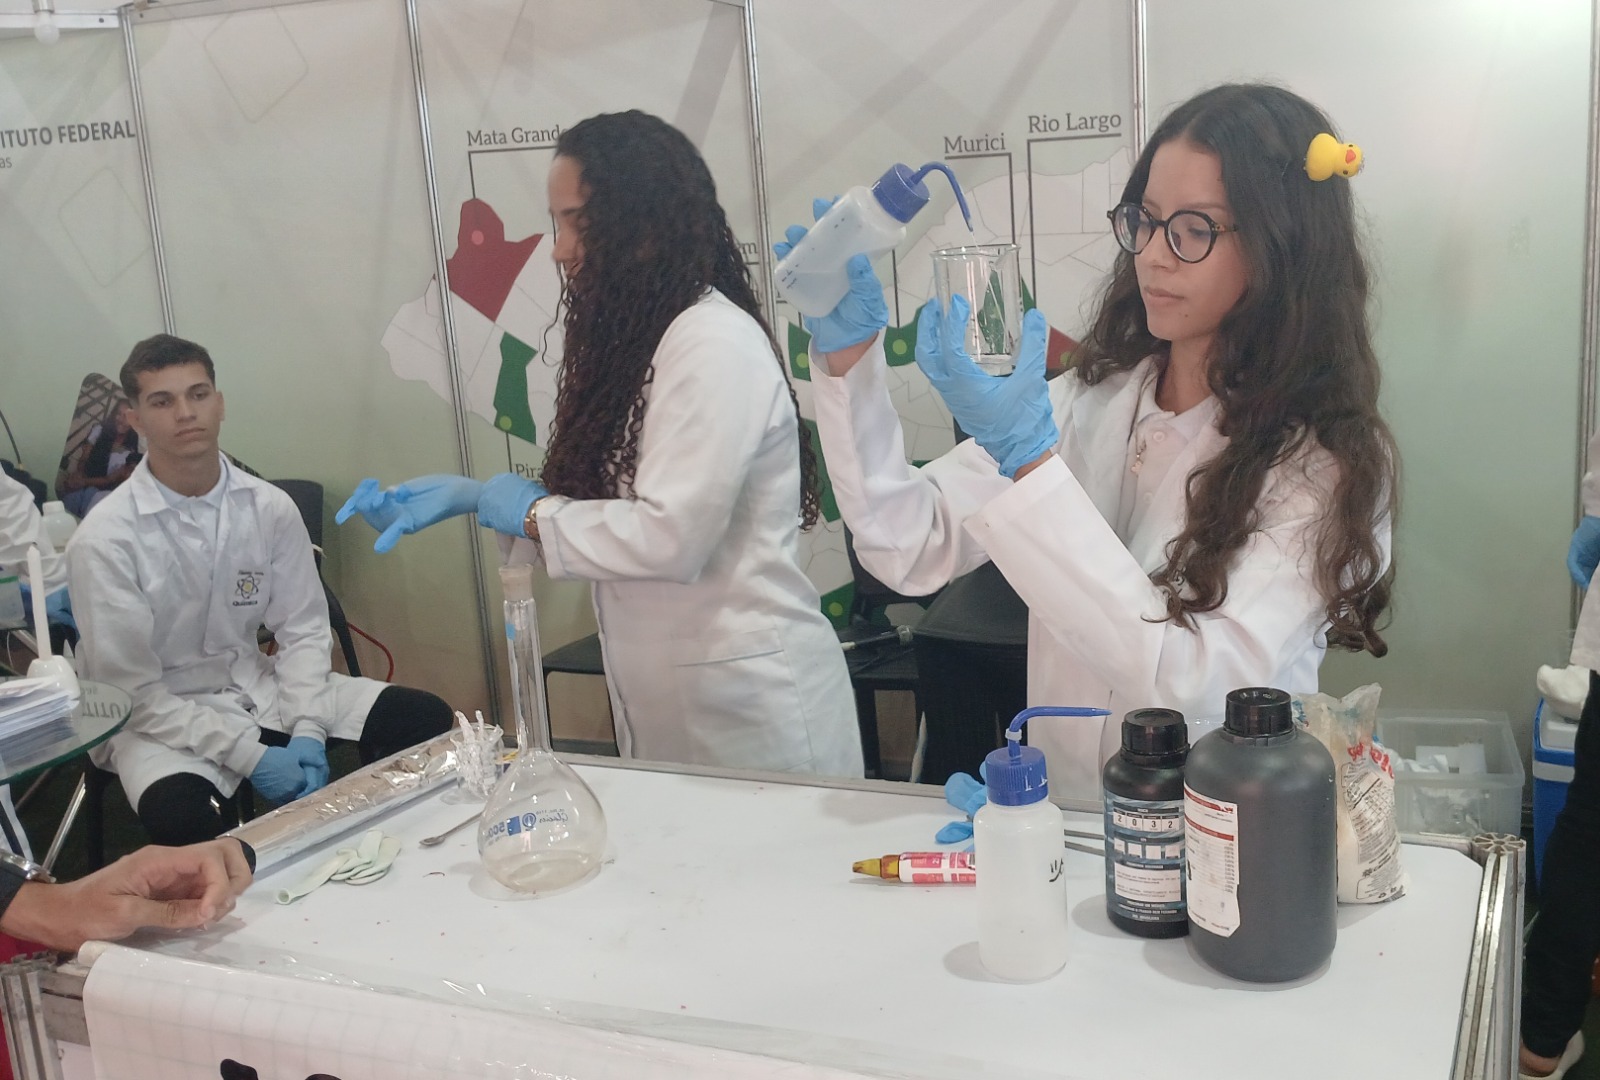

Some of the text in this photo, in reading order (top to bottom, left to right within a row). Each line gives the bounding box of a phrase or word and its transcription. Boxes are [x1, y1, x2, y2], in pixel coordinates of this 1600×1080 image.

[1028, 112, 1122, 133] Rio Largo
[0, 120, 136, 149] ITUTO FEDERAL
[466, 129, 507, 146] Mata
[944, 132, 1006, 153] Murici
[1132, 818, 1137, 827] 0
[1151, 820, 1156, 828] 3
[1168, 820, 1173, 828] 2
